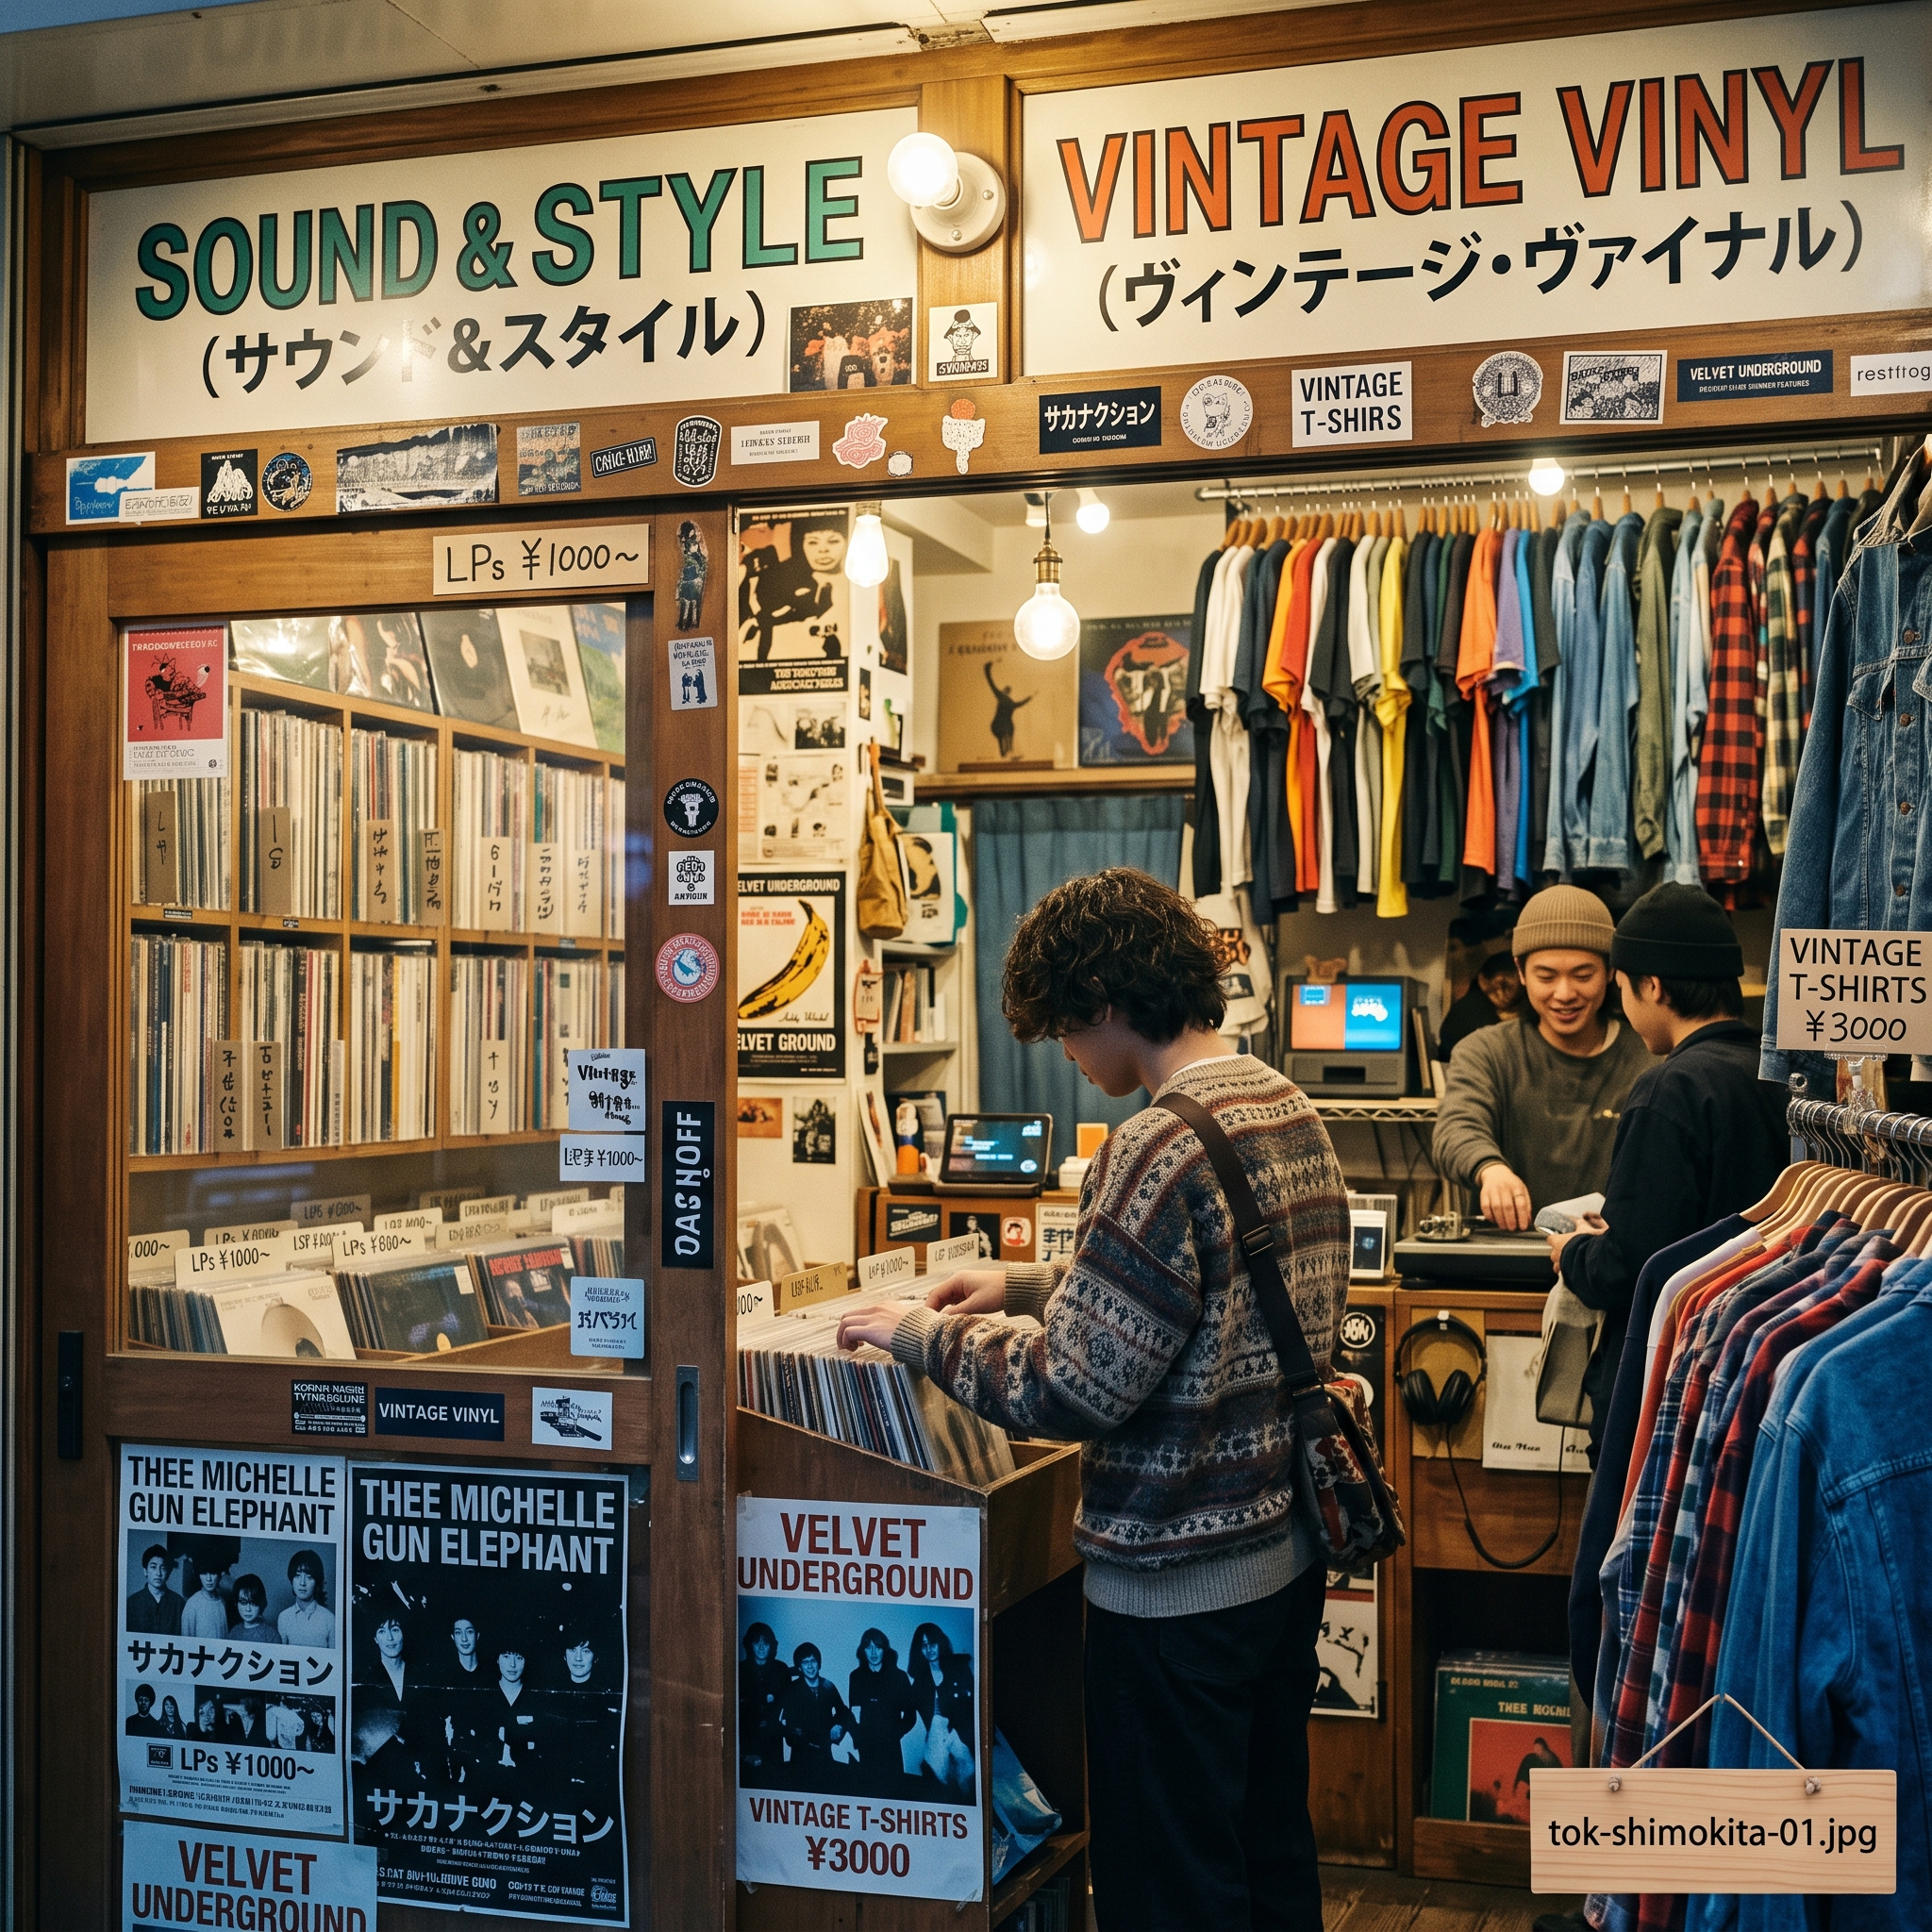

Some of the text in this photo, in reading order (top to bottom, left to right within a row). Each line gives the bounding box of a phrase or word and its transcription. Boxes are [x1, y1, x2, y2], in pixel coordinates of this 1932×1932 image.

[1056, 57, 1905, 244] VINTAGE VINYL
[135, 155, 864, 322] SOUND & STYLE
[1300, 371, 1404, 402] VINTAGE
[1690, 359, 1822, 381] VELVET UNDERGROUND
[1044, 400, 1156, 432] サカナクション
[1301, 405, 1402, 436] T-SHIRS
[447, 538, 639, 582] LPs ¥1000~
[767, 878, 841, 892] UNDERGROUND
[1790, 937, 1922, 967] VINTAGE
[1789, 974, 1927, 1005] T-SHIRTS
[778, 1033, 837, 1052] GROUND
[1806, 1009, 1907, 1042] ¥3000
[192, 1252, 215, 1273] LPs
[378, 1402, 500, 1424] VINTAGE VINYL
[127, 1455, 336, 1499] THEE MICHELLE
[128, 1491, 335, 1535] GUN ELEPHANT
[359, 1478, 615, 1529] THEE MICHELLE
[362, 1523, 614, 1574] GUN ELEPHANT
[780, 1512, 926, 1558] VELVET
[738, 1557, 974, 1601] UNDERGROUND
[127, 1640, 334, 1687] サカナクション
[180, 1747, 315, 1780] LPs ¥1000~
[366, 1788, 614, 1844] サカナクション
[749, 1797, 968, 1839] VINTAGE T-SHIRTS
[177, 1840, 318, 1895] VELVET
[805, 1835, 910, 1877] ¥3000
[132, 1882, 367, 1932] UNDERGROUND
